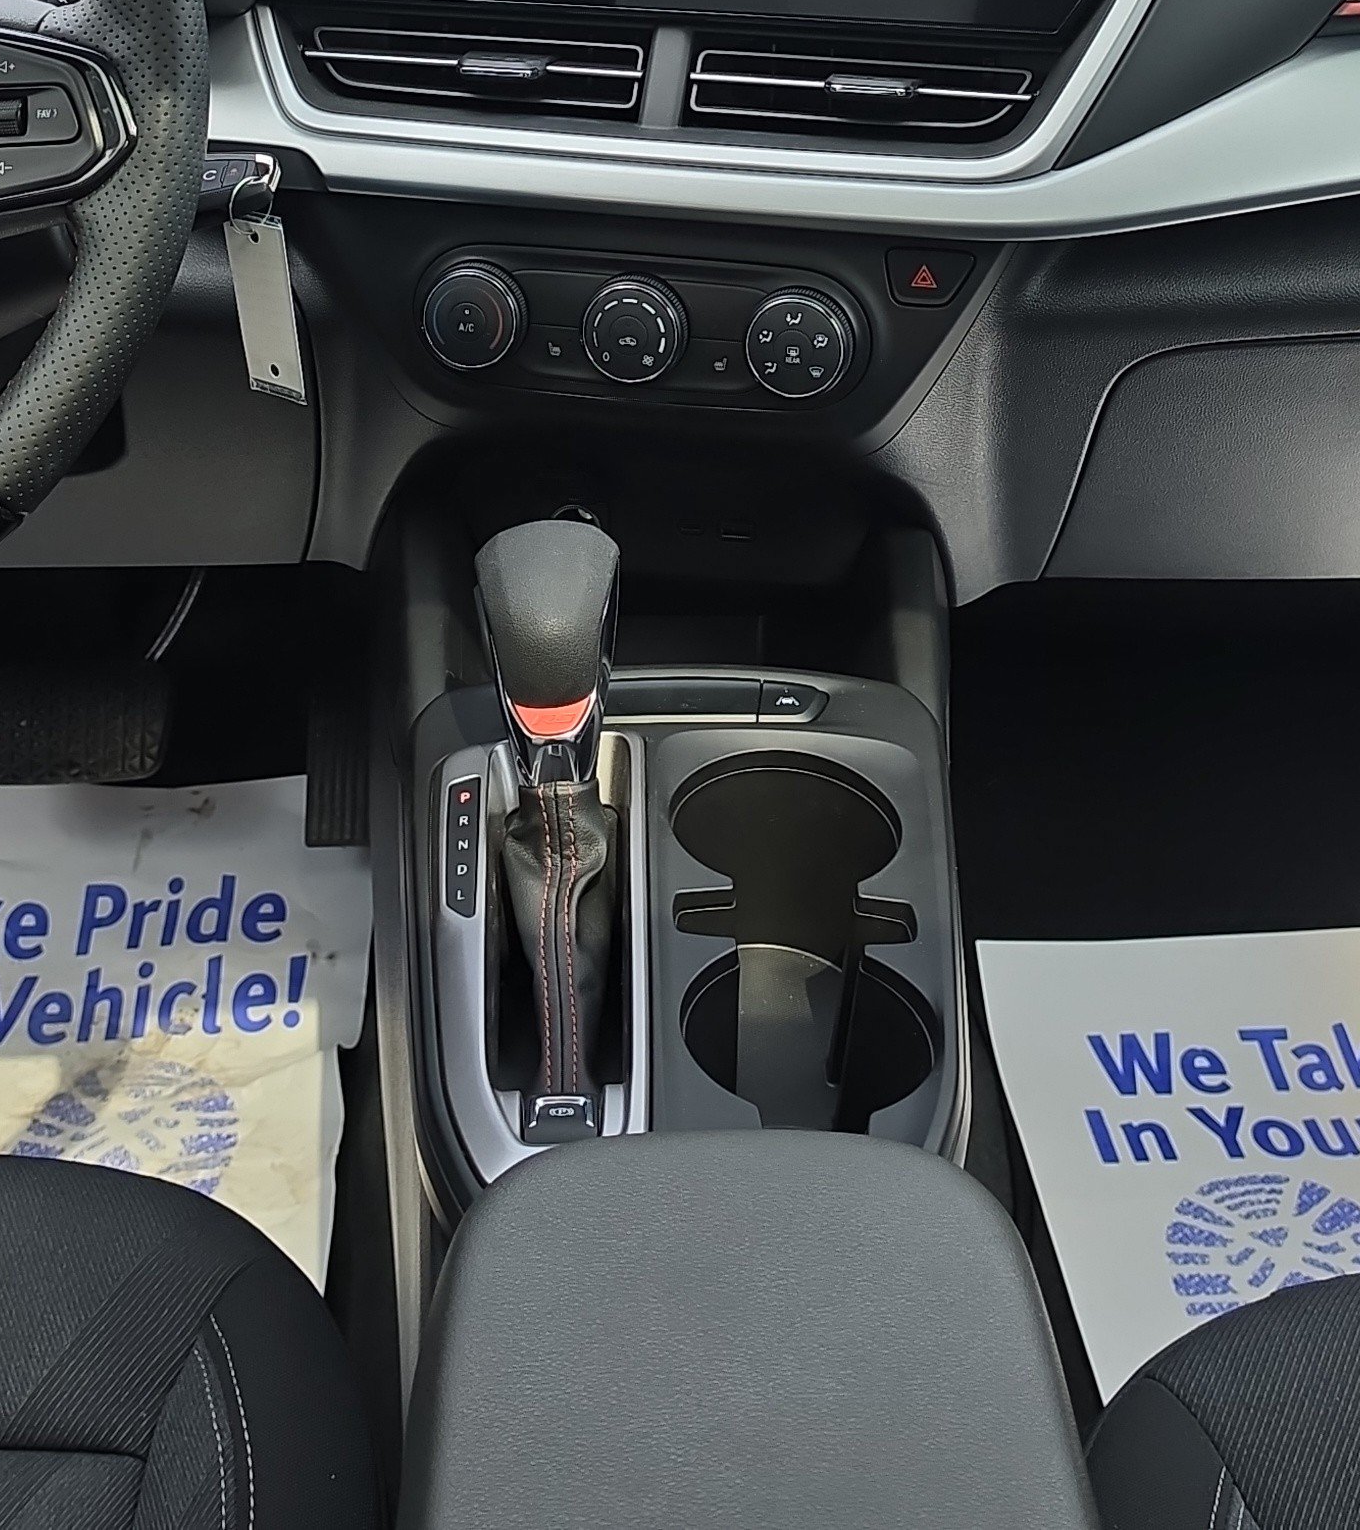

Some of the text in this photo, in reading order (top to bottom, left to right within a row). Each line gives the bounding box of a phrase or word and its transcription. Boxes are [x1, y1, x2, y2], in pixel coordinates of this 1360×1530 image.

[37, 109, 50, 118] FAV
[459, 322, 474, 333] A/C
[460, 792, 470, 803] P
[459, 816, 469, 826] R
[458, 839, 468, 850] N
[457, 864, 467, 875] D
[457, 890, 465, 900] L
[75, 875, 286, 955] Pride
[1086, 1031, 1232, 1097] We
[1085, 1108, 1178, 1164] In
